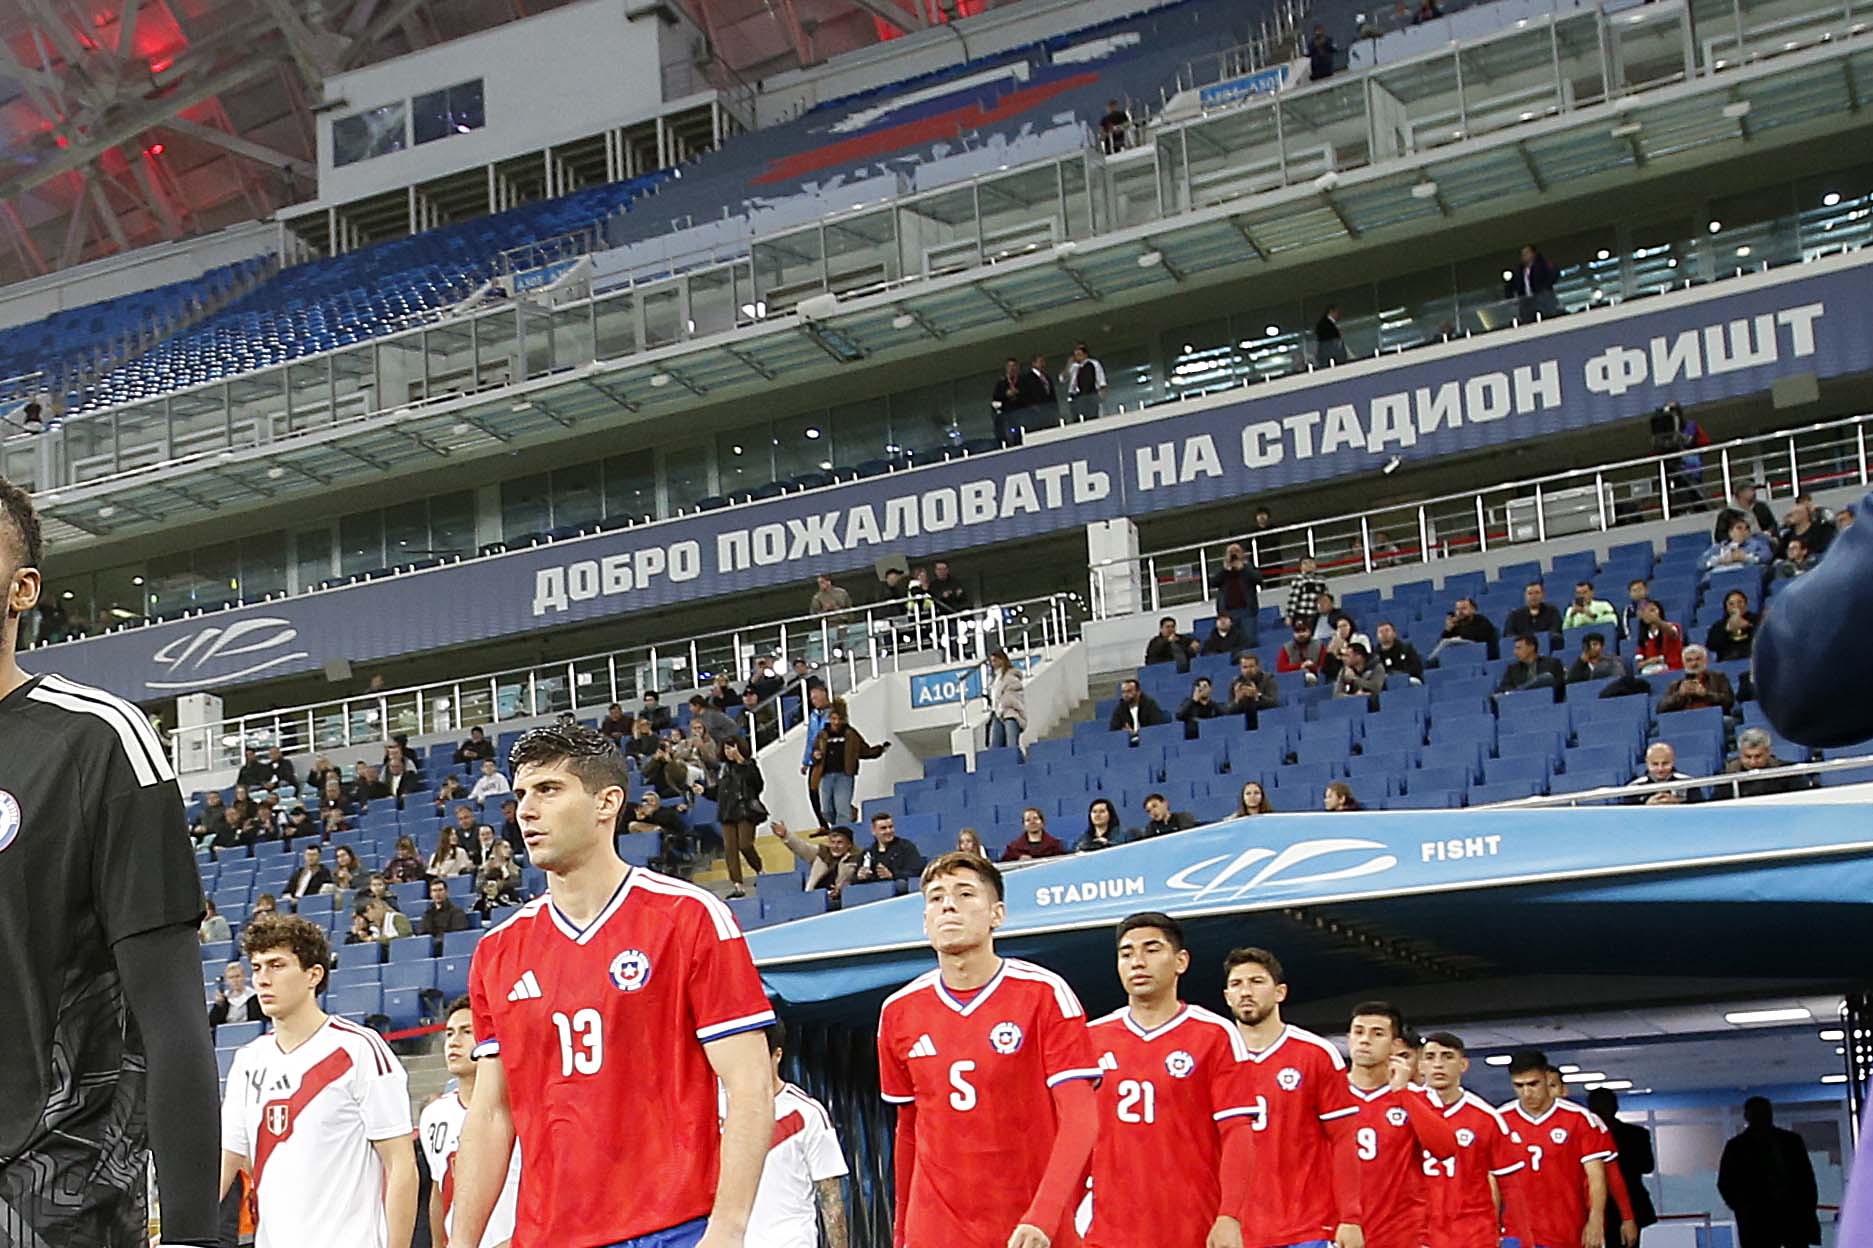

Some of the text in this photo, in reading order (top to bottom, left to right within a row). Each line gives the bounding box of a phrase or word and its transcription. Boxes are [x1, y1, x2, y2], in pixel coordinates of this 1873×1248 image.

[532, 303, 1825, 617] ДОБРО ПОЖАЛОВАТЬ НА СТАДИОН ФИШТ
[1036, 835, 1501, 906] STADIUM FISHT
[552, 1008, 603, 1077] 13
[245, 1067, 267, 1104] 14
[949, 1060, 977, 1111] 5
[1117, 1080, 1155, 1123] 21
[1357, 1127, 1377, 1161] 9
[1527, 1145, 1544, 1172] 7
